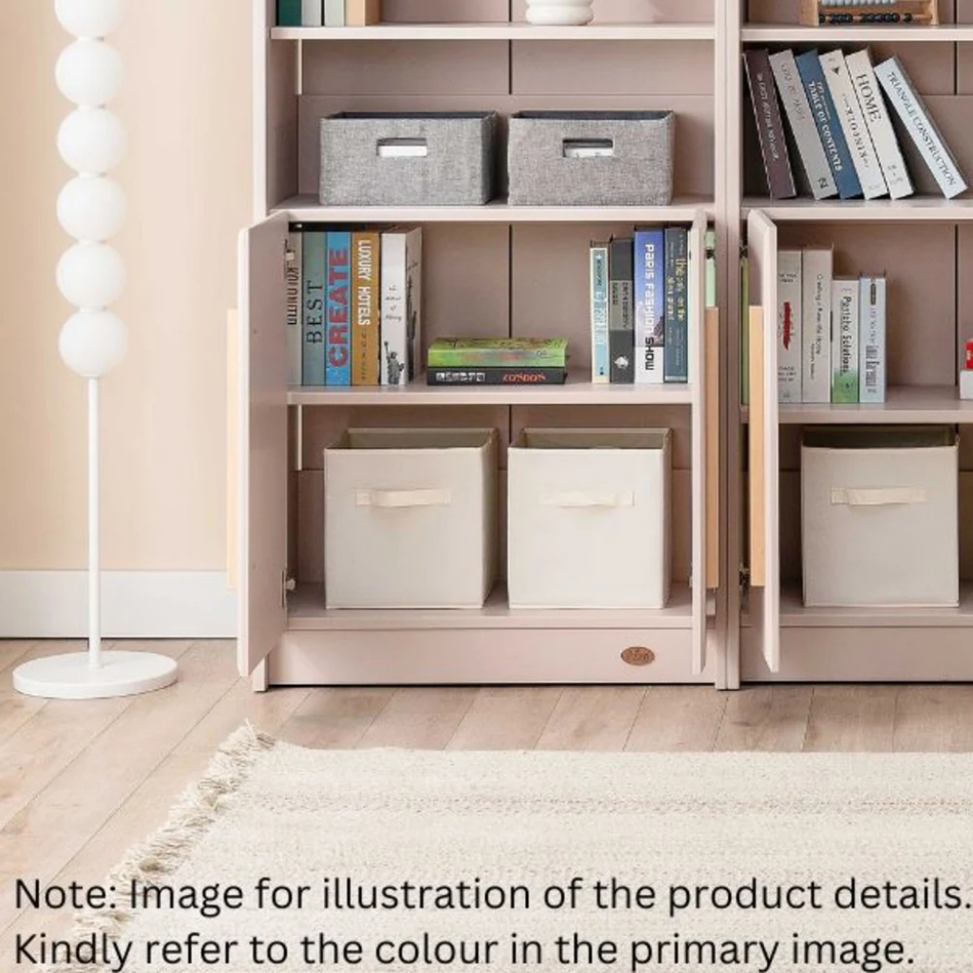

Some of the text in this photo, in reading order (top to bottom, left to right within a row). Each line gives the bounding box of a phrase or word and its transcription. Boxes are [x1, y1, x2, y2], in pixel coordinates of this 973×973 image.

[855, 74, 882, 123] HOME
[887, 72, 956, 186] TRIANGLE CONSTRUCTION
[358, 240, 371, 280] LUXURY
[306, 279, 323, 344] BEST
[328, 248, 348, 368] CREATE
[358, 287, 371, 325] HOTELS
[645, 337, 654, 371] SHOW
[843, 335, 851, 373] Solutions
[503, 373, 546, 382] LONDON
